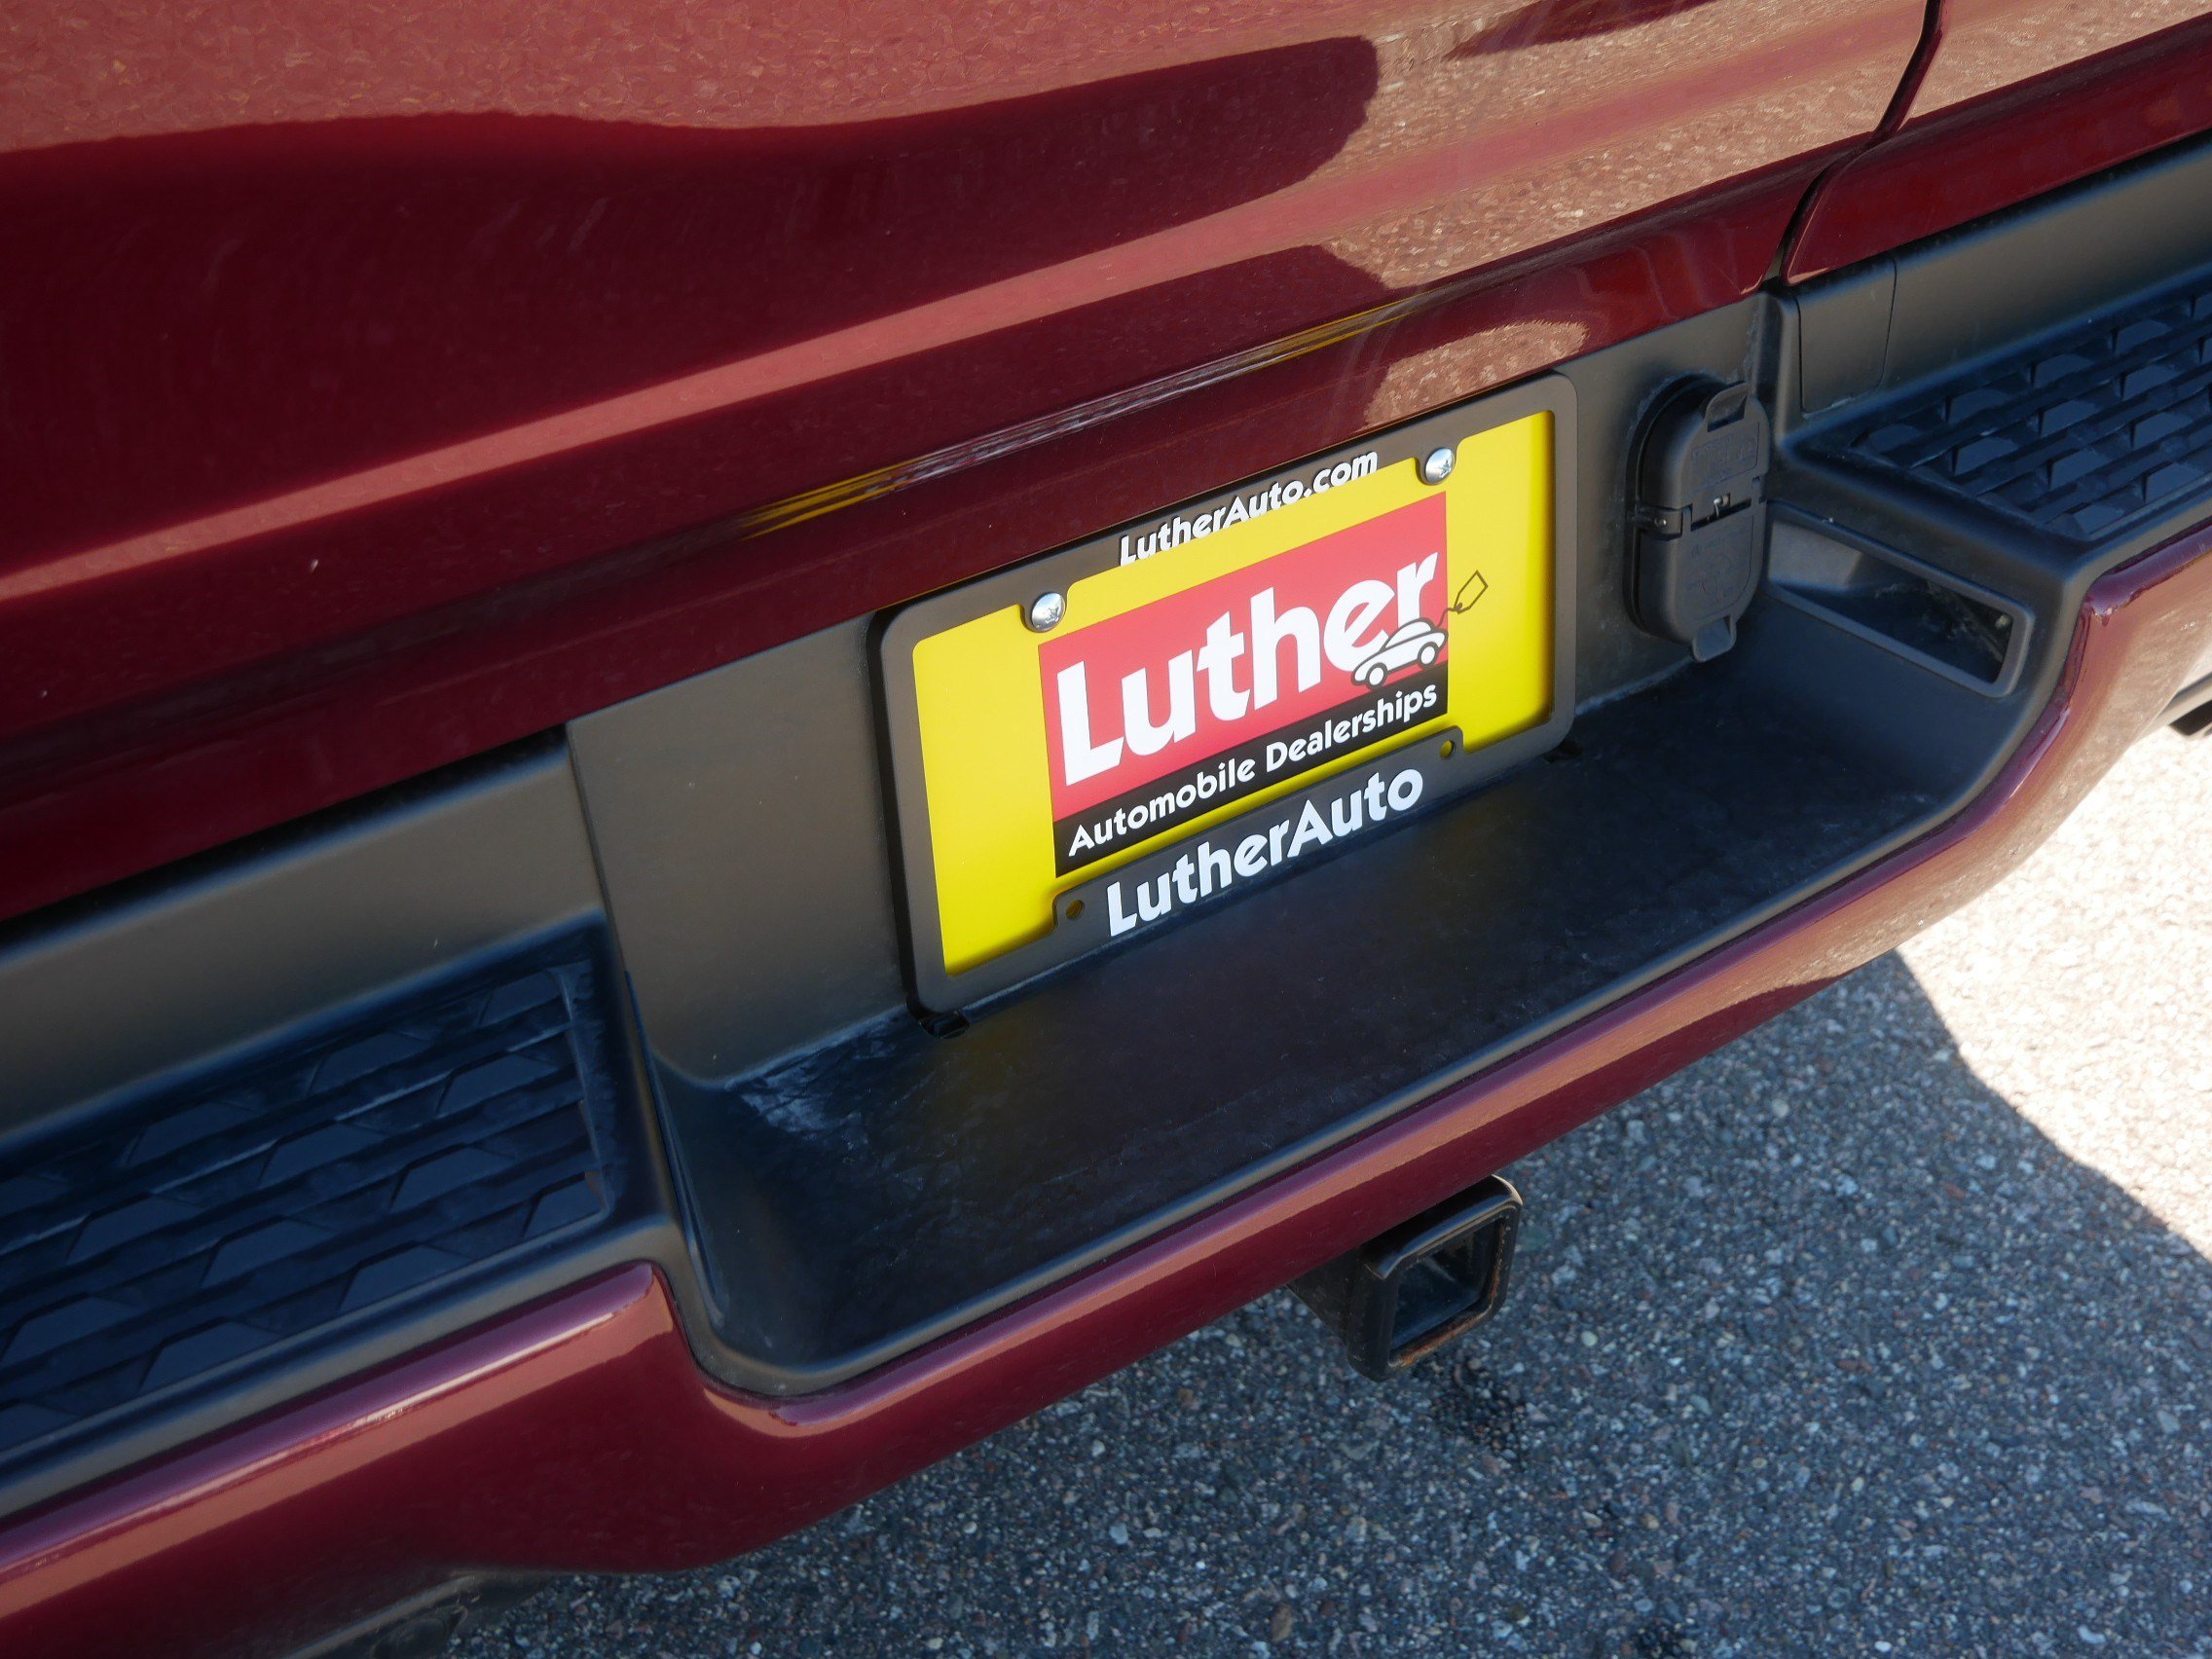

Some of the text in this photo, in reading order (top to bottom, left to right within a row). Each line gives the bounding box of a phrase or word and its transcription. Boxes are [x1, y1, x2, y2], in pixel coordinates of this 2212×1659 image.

[1120, 451, 1378, 567] LutherAuto.com
[1056, 552, 1438, 786] Luther
[1069, 683, 1437, 857] Automobile Dealerships
[1107, 768, 1423, 937] LutherAuto
